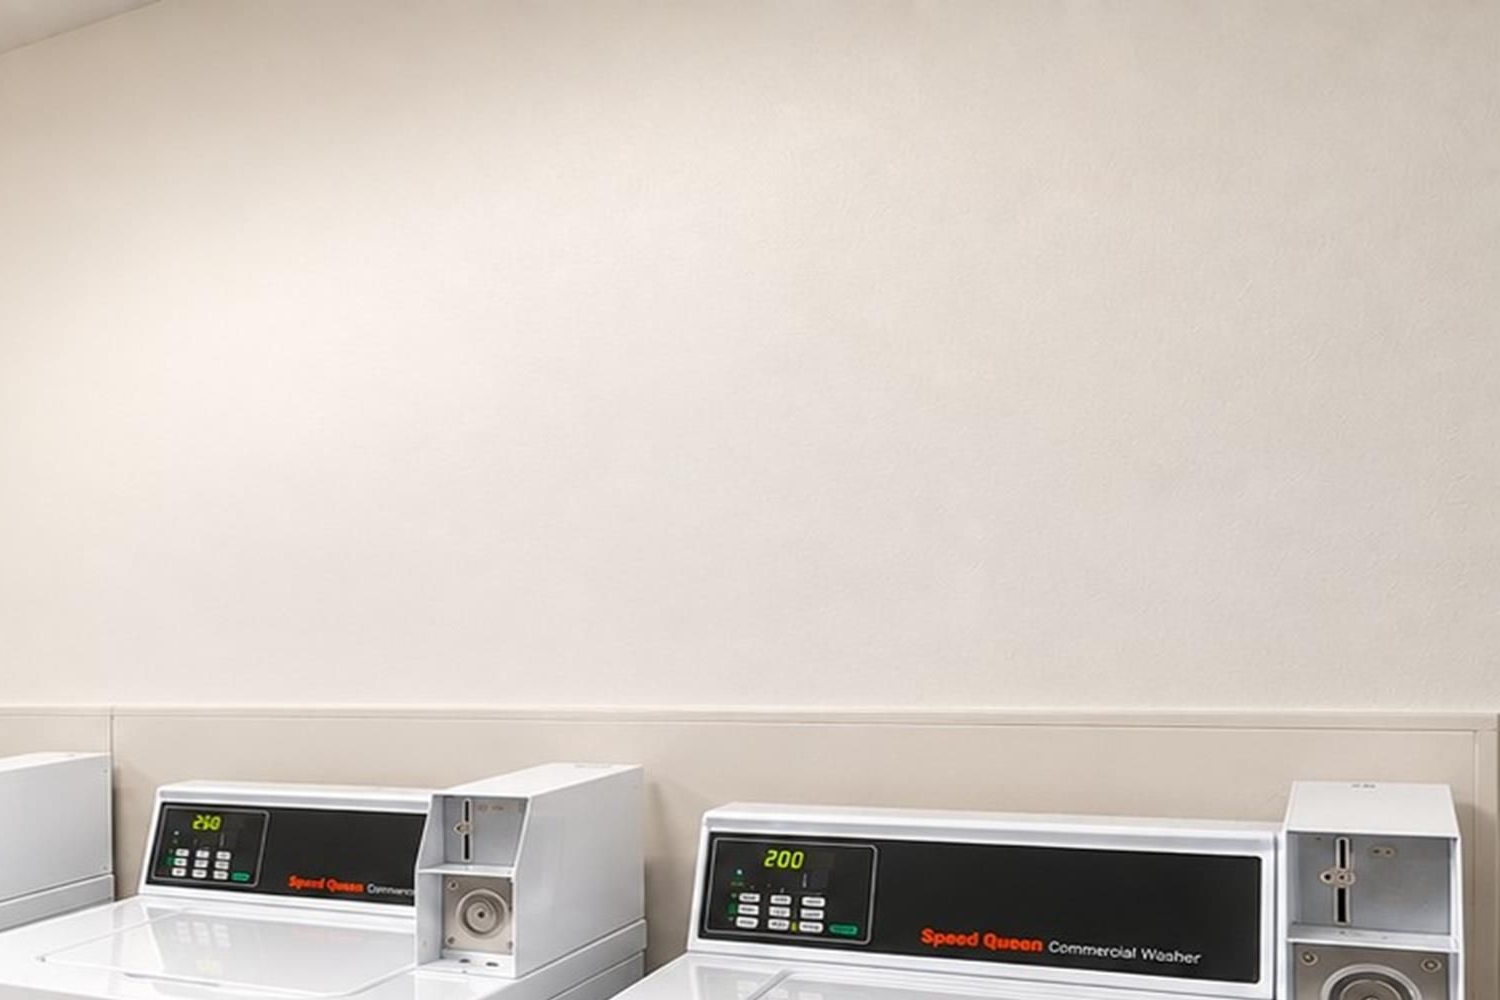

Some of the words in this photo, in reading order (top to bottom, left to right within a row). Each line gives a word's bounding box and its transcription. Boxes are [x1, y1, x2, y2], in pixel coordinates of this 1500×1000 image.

[764, 849, 804, 869] 200
[921, 928, 979, 948] Speed
[983, 933, 1043, 952] Queen
[1048, 940, 1137, 959] Commercial
[1141, 947, 1202, 965] Washer
